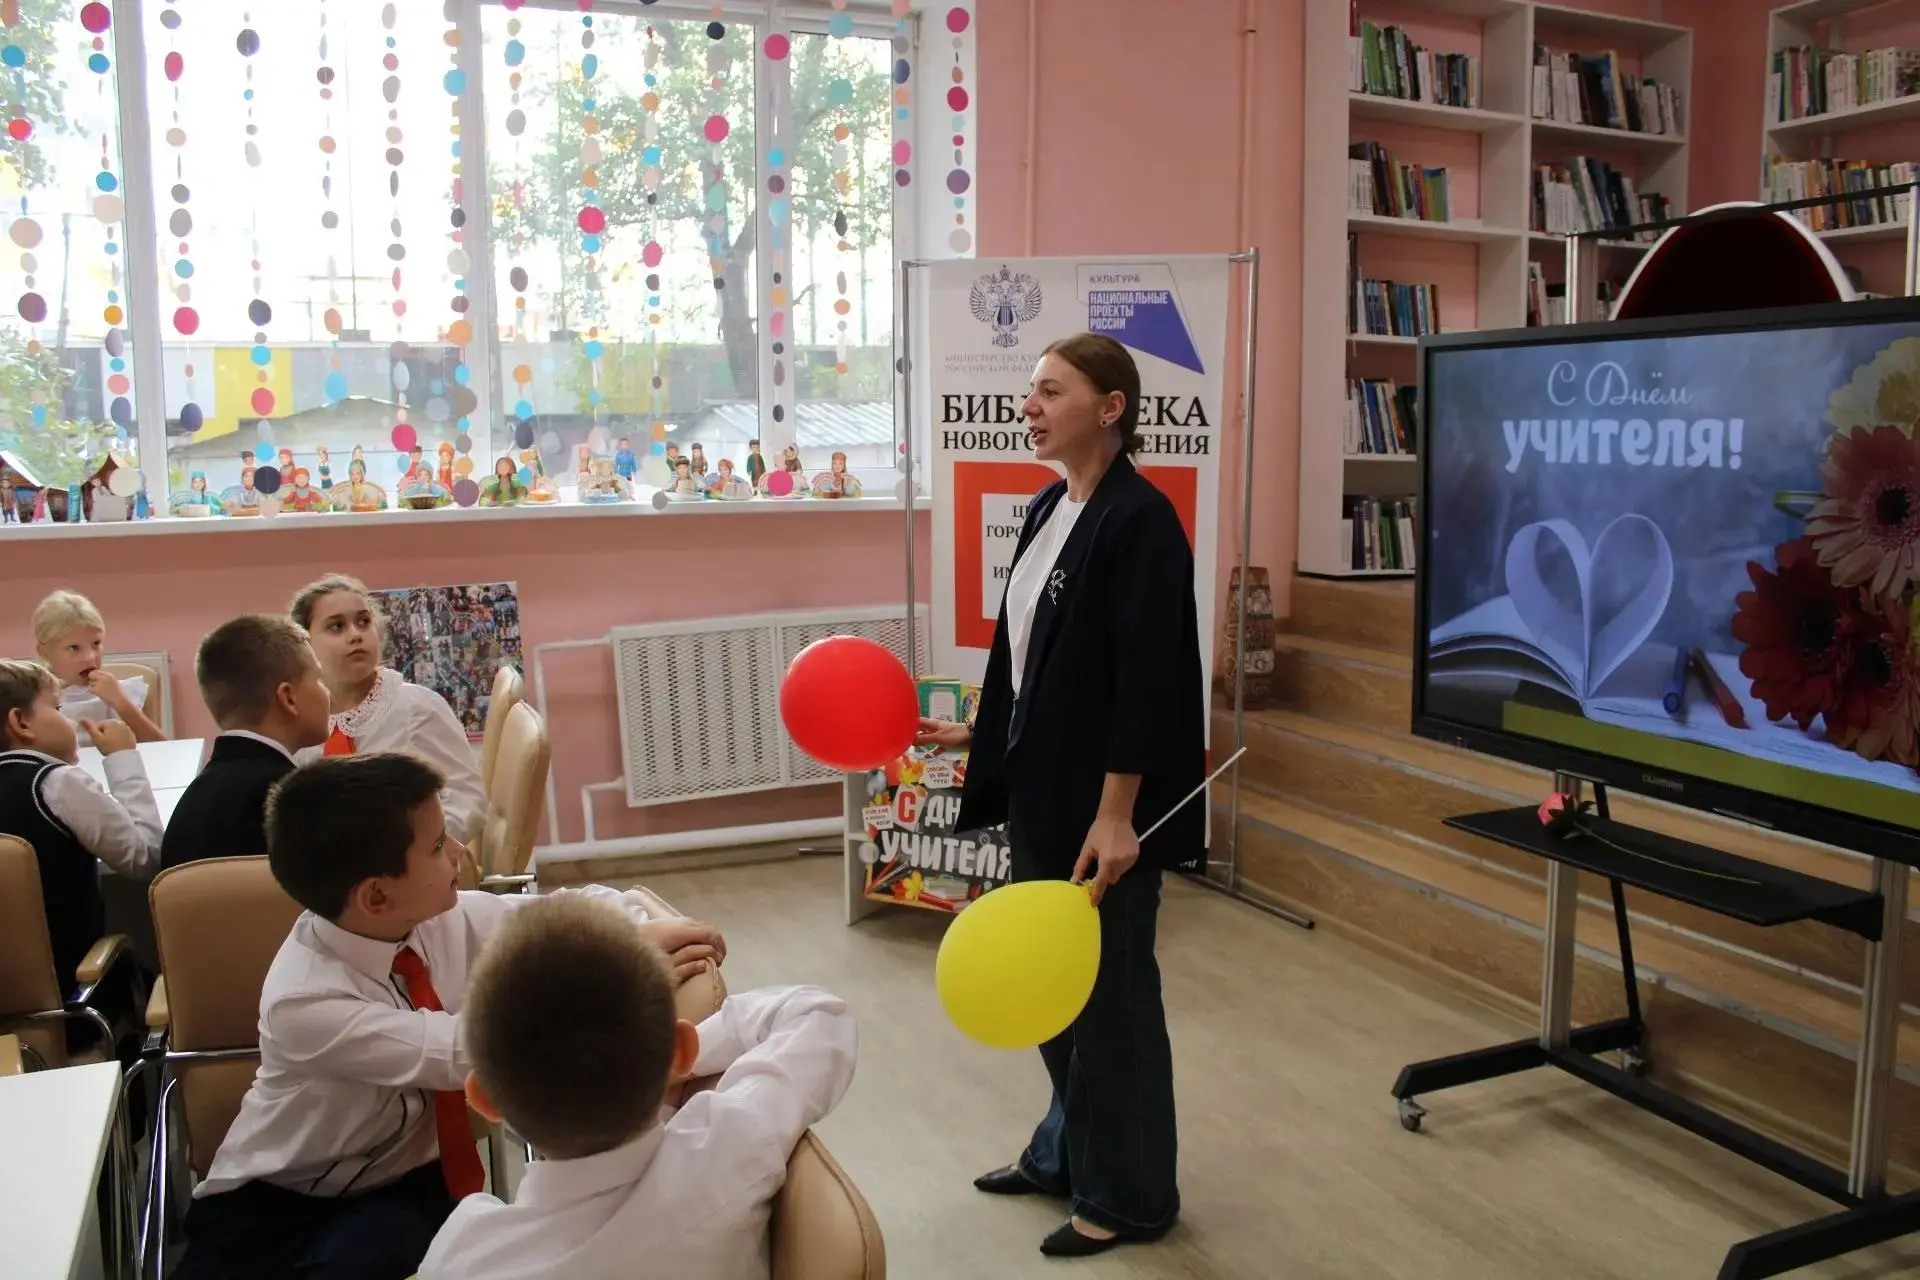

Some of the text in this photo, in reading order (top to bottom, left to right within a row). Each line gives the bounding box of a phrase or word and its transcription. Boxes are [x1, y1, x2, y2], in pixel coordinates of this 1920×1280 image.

[1089, 273, 1141, 284] КУЛЬТУРА
[1090, 291, 1169, 304] НАЦИОНАЛЬНЫЕ
[1090, 304, 1134, 317] ПРОЕКТЫ
[1090, 317, 1126, 330] РОССИИ
[1547, 359, 1694, 407] С Днём
[897, 790, 917, 823] С
[880, 830, 1011, 880] УЧИТЕЛЯ
